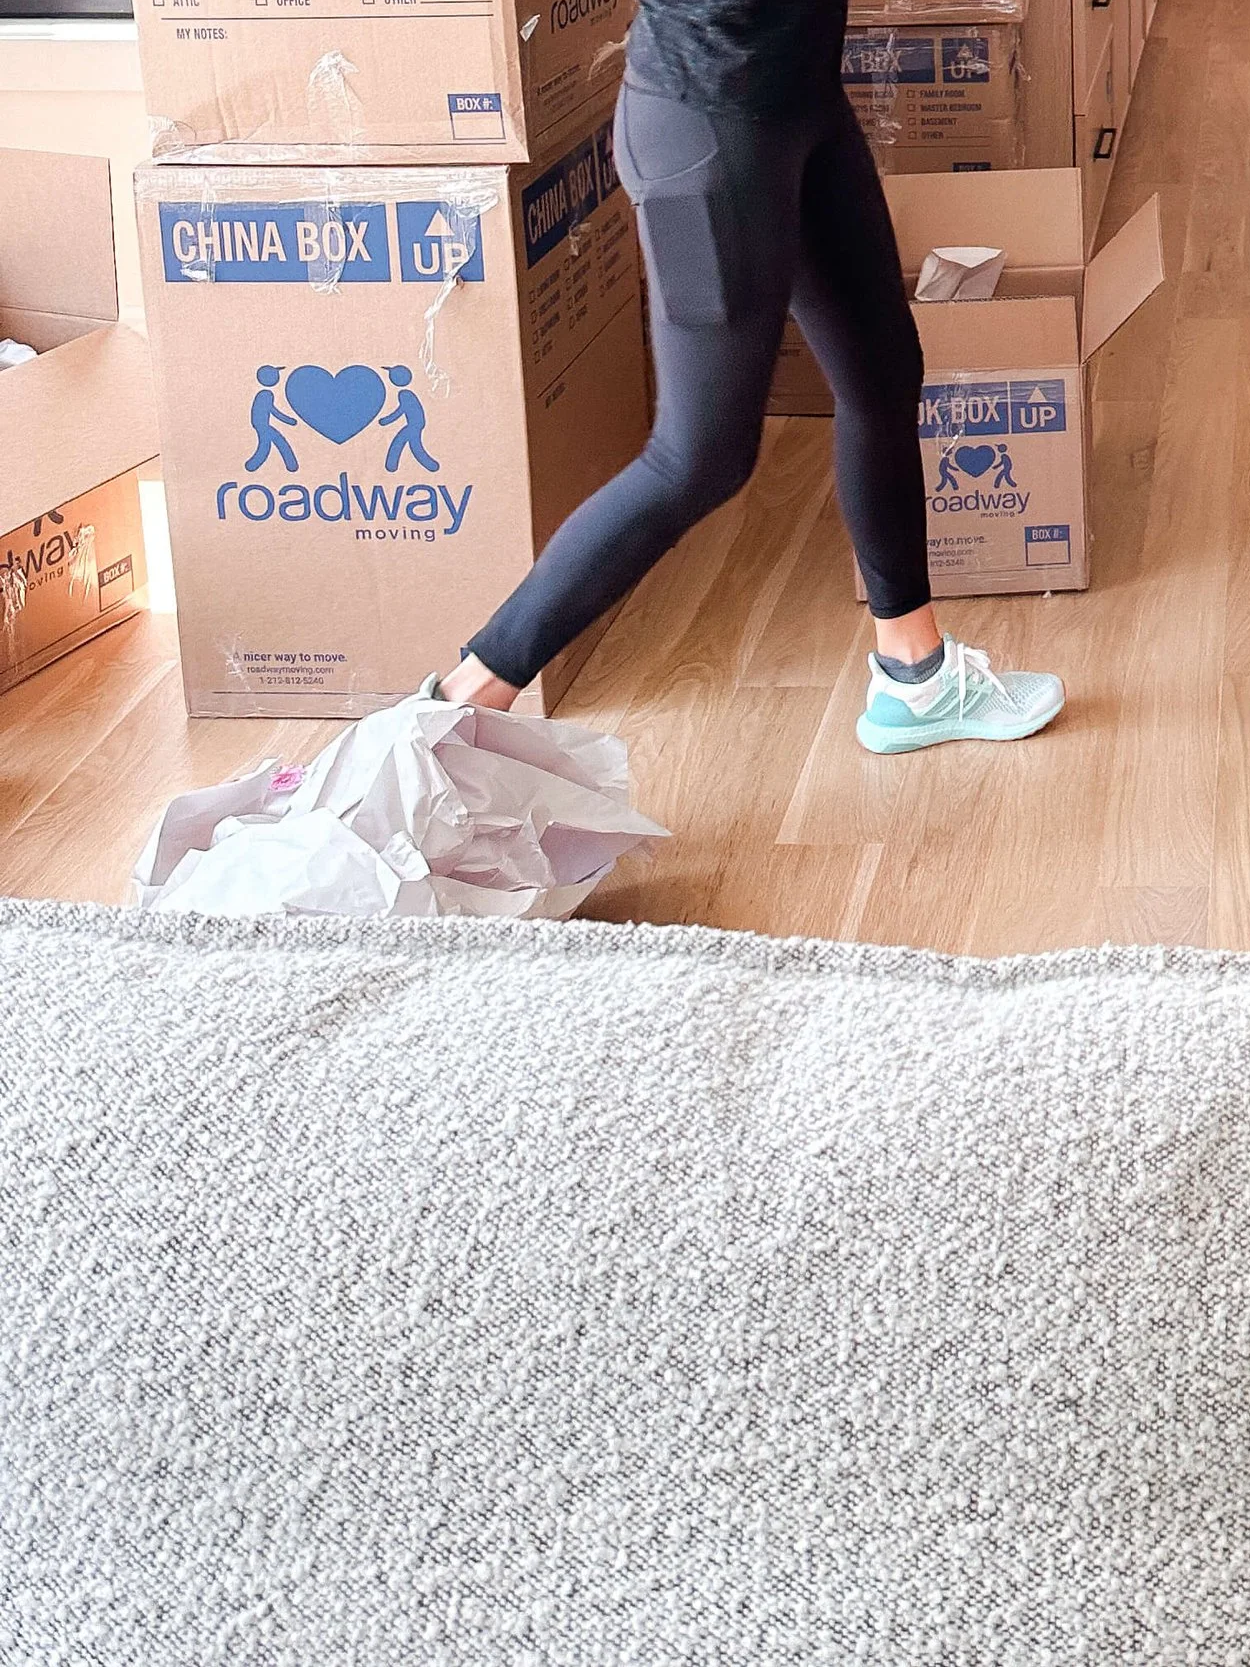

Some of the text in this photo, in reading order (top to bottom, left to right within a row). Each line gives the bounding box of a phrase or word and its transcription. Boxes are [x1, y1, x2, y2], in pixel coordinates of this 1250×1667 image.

[176, 27, 228, 41] MY NOTES:
[456, 97, 482, 112] BOX
[527, 155, 595, 245] CHINA BOX
[172, 221, 372, 263] CHINA BOX
[413, 241, 470, 274] UP
[952, 397, 1000, 424] BOX
[1020, 406, 1057, 429] UP
[215, 472, 473, 535] roadway
[355, 527, 437, 543] moving
[1032, 528, 1051, 541] BOX
[243, 652, 272, 663] nicer
[274, 653, 296, 665] way
[299, 652, 311, 663] to
[313, 652, 348, 663] move.
